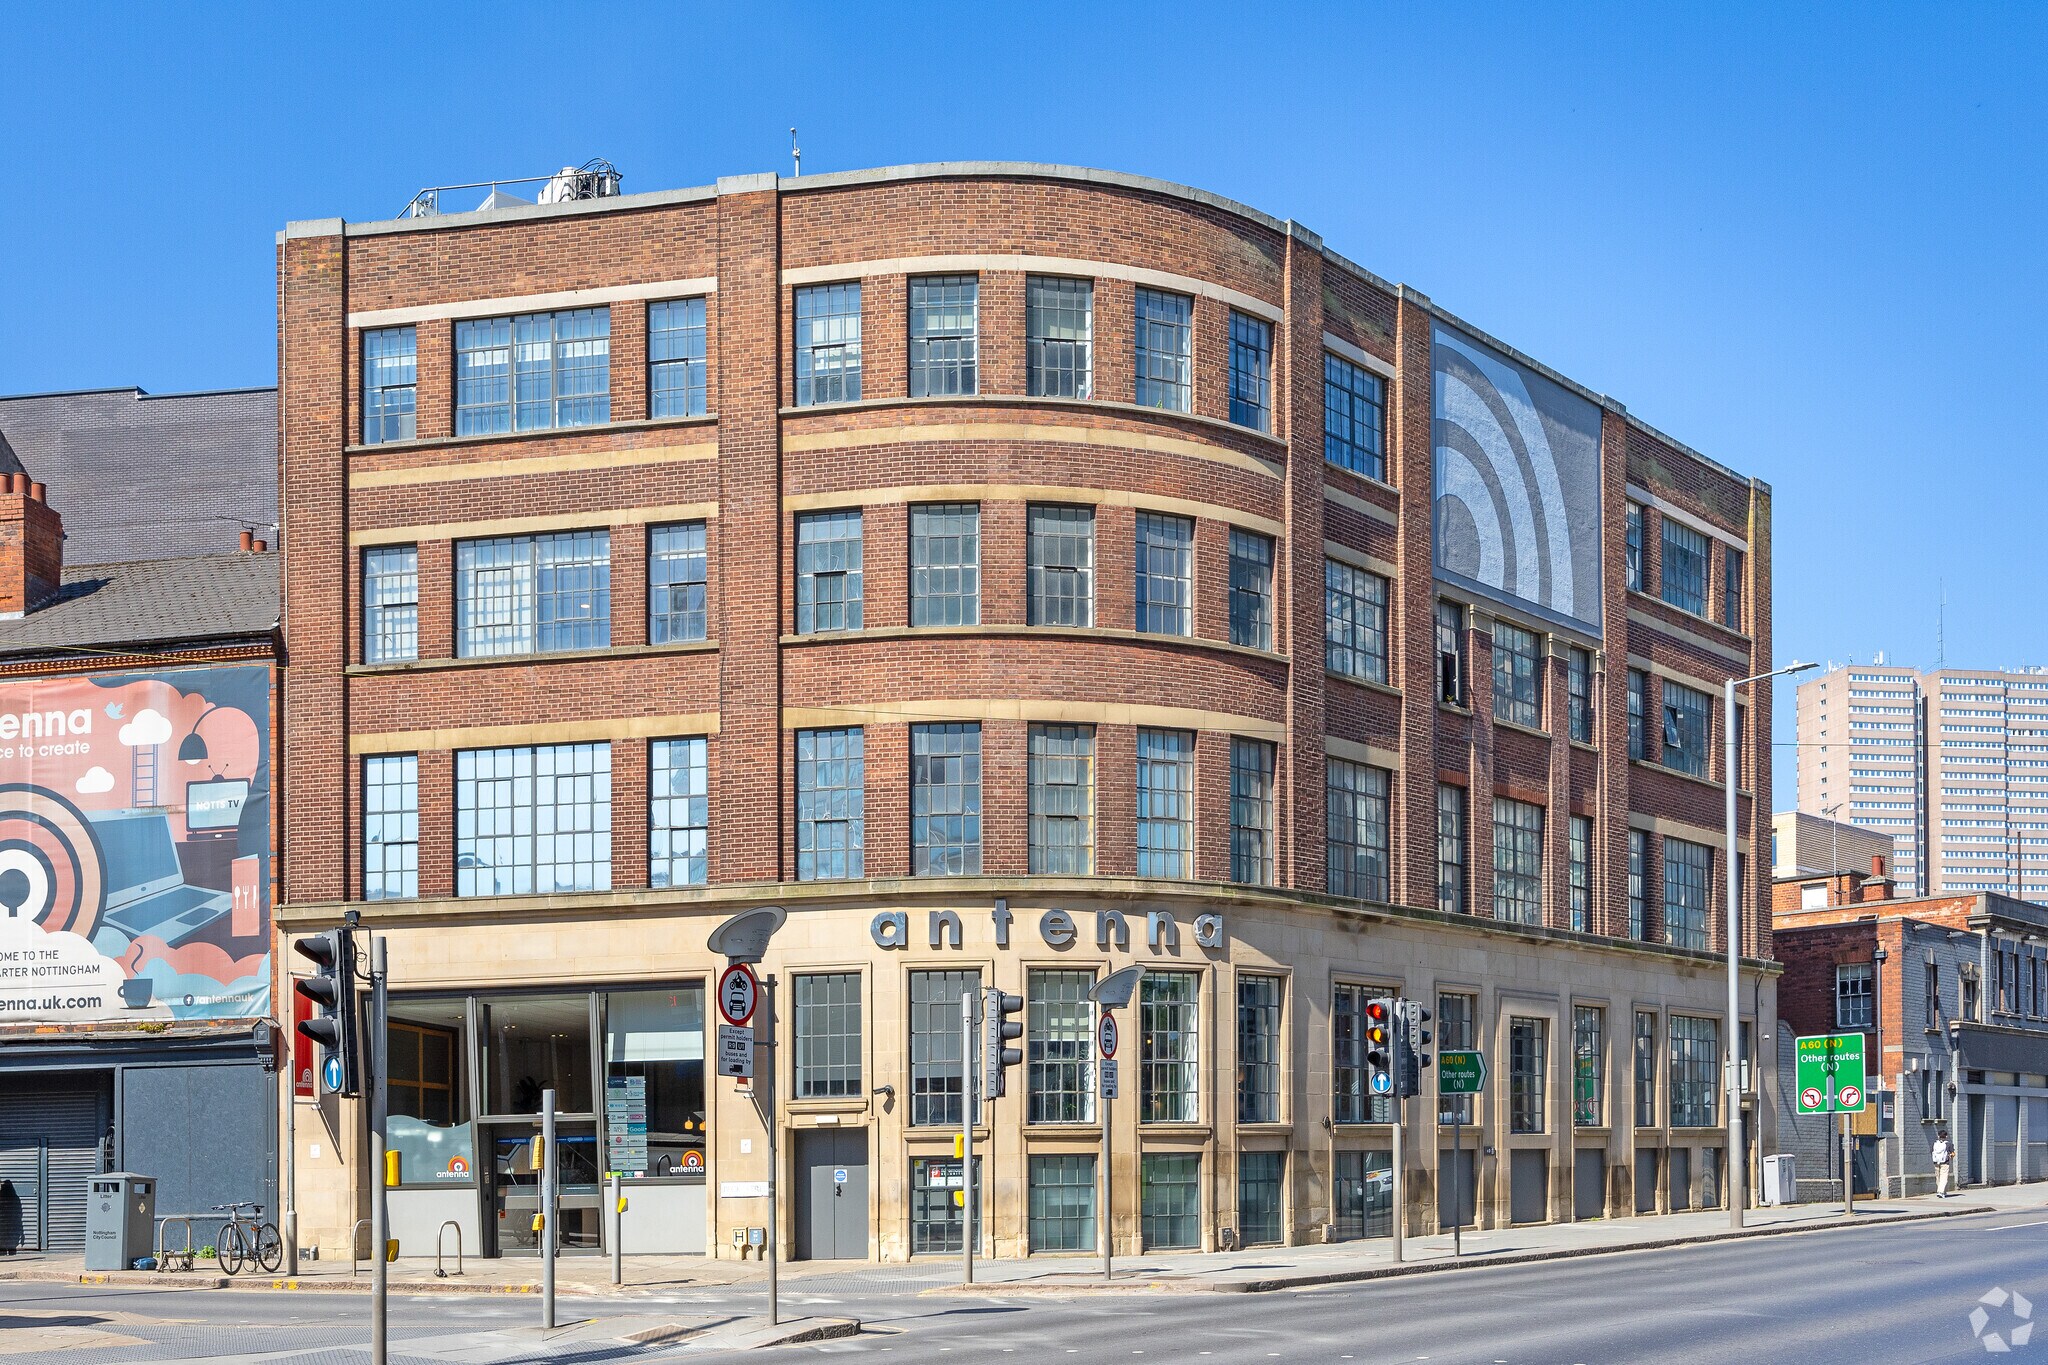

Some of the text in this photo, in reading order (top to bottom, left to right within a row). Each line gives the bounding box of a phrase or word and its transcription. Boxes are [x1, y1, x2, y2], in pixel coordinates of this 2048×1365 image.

[0, 708, 92, 740] enna
[19, 743, 34, 758] to
[38, 740, 90, 757] create
[196, 799, 239, 811] NOTTS TV
[869, 898, 1224, 948] antenna
[23, 951, 36, 961] TO
[39, 950, 59, 960] THE
[0, 965, 100, 977] RTER NOTTINGHAM
[1800, 1038, 1843, 1050] A60 (N)
[1441, 1055, 1466, 1065] A60 (N)
[1800, 1052, 1860, 1063] Other routes
[1820, 1062, 1840, 1072] (N)
[1441, 1070, 1457, 1078] Other
[1453, 1079, 1465, 1089] (N)
[436, 1170, 469, 1178] antenna
[669, 1166, 704, 1174] antenna
[735, 1231, 744, 1242] H
